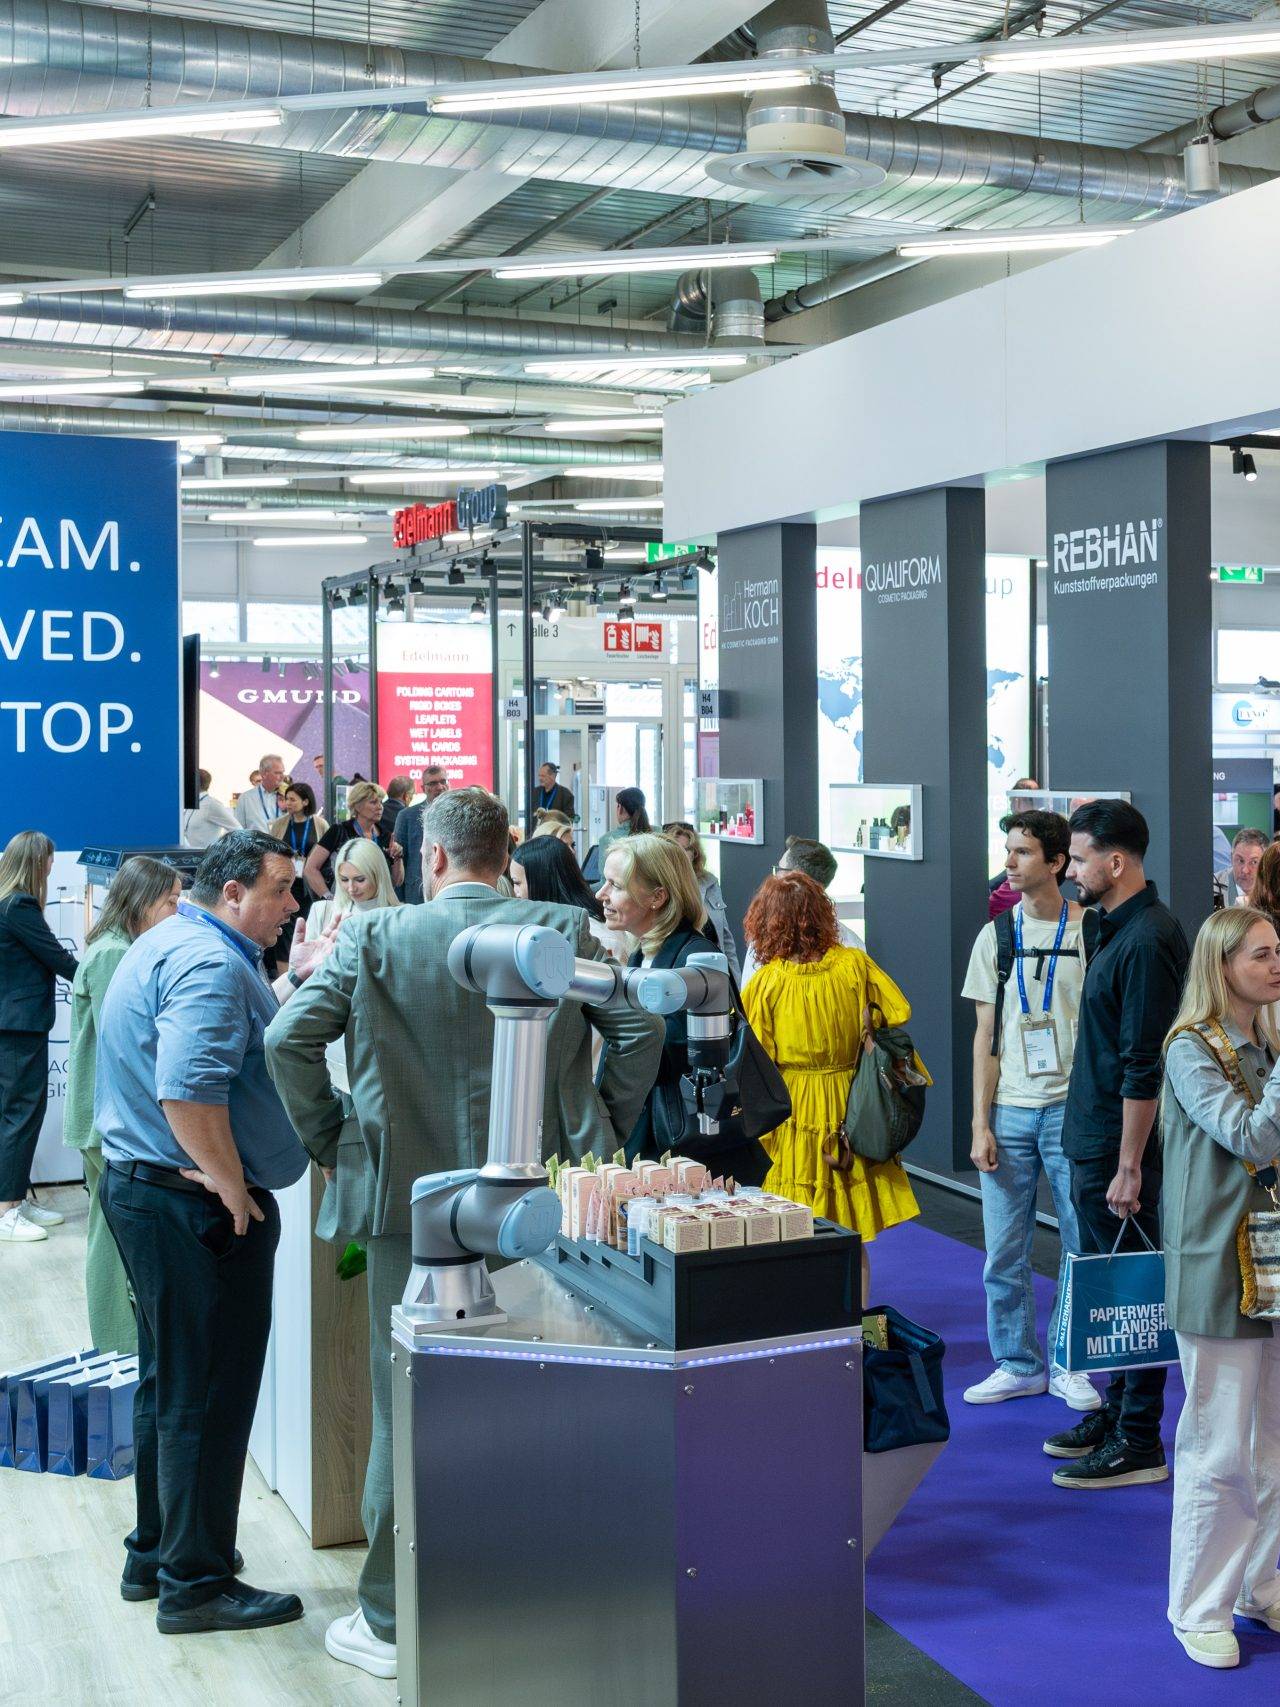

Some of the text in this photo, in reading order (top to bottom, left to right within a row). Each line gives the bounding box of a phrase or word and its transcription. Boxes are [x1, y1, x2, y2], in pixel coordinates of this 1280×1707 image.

[0, 516, 141, 572] AM.
[865, 555, 942, 592] QUALIFORM
[744, 579, 778, 598] Hermann
[1054, 572, 1158, 595] Kunststoffverpackungen
[877, 589, 928, 604] COSMETIC PACKAGING
[744, 598, 779, 629] KOCH
[533, 624, 559, 638] alle 3
[402, 650, 470, 663] Edelmann
[237, 688, 362, 704] GMUND
[396, 686, 475, 698] FOLDING CARTONS
[702, 694, 711, 703] H4
[508, 700, 519, 708] H4
[701, 705, 713, 715] B04
[415, 714, 457, 725] LEAFLETS
[506, 709, 521, 718] B03
[409, 728, 463, 738] WET LABELS
[431, 742, 461, 752] CARDS
[394, 755, 478, 766] SYSTEM PACKAGING
[1086, 1331, 1159, 1356] MITTLER
